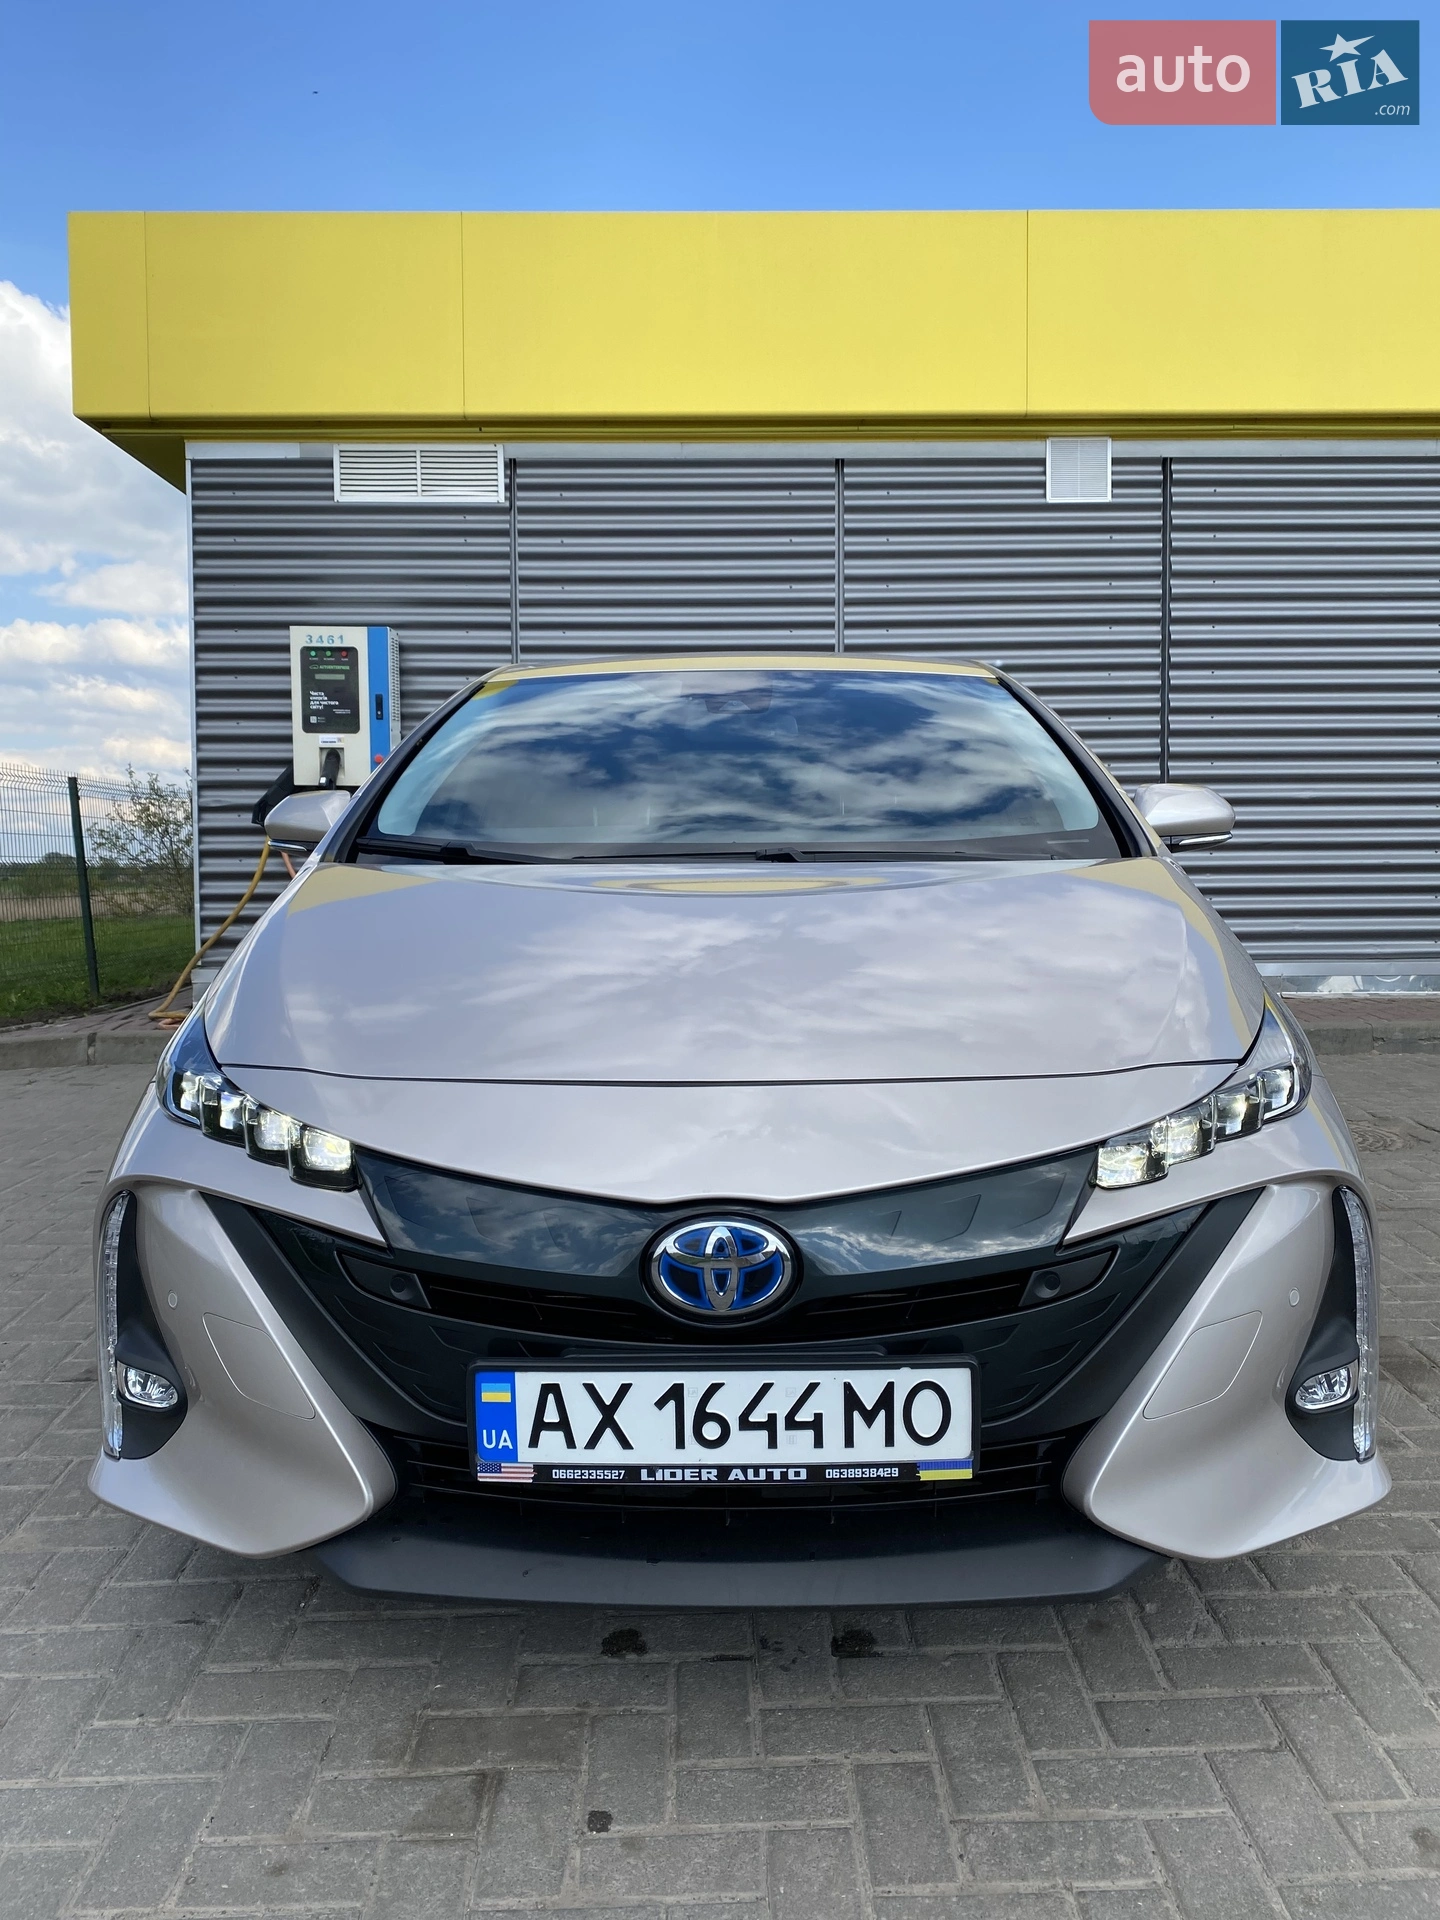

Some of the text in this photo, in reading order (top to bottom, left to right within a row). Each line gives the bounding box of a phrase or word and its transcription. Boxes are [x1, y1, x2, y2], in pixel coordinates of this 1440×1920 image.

[305, 634, 344, 645] 3461
[528, 1380, 952, 1450] AX 1644 MO
[482, 1429, 514, 1449] UA
[552, 1467, 899, 1481] 0662335527 LIDER AUTO 0638938429
